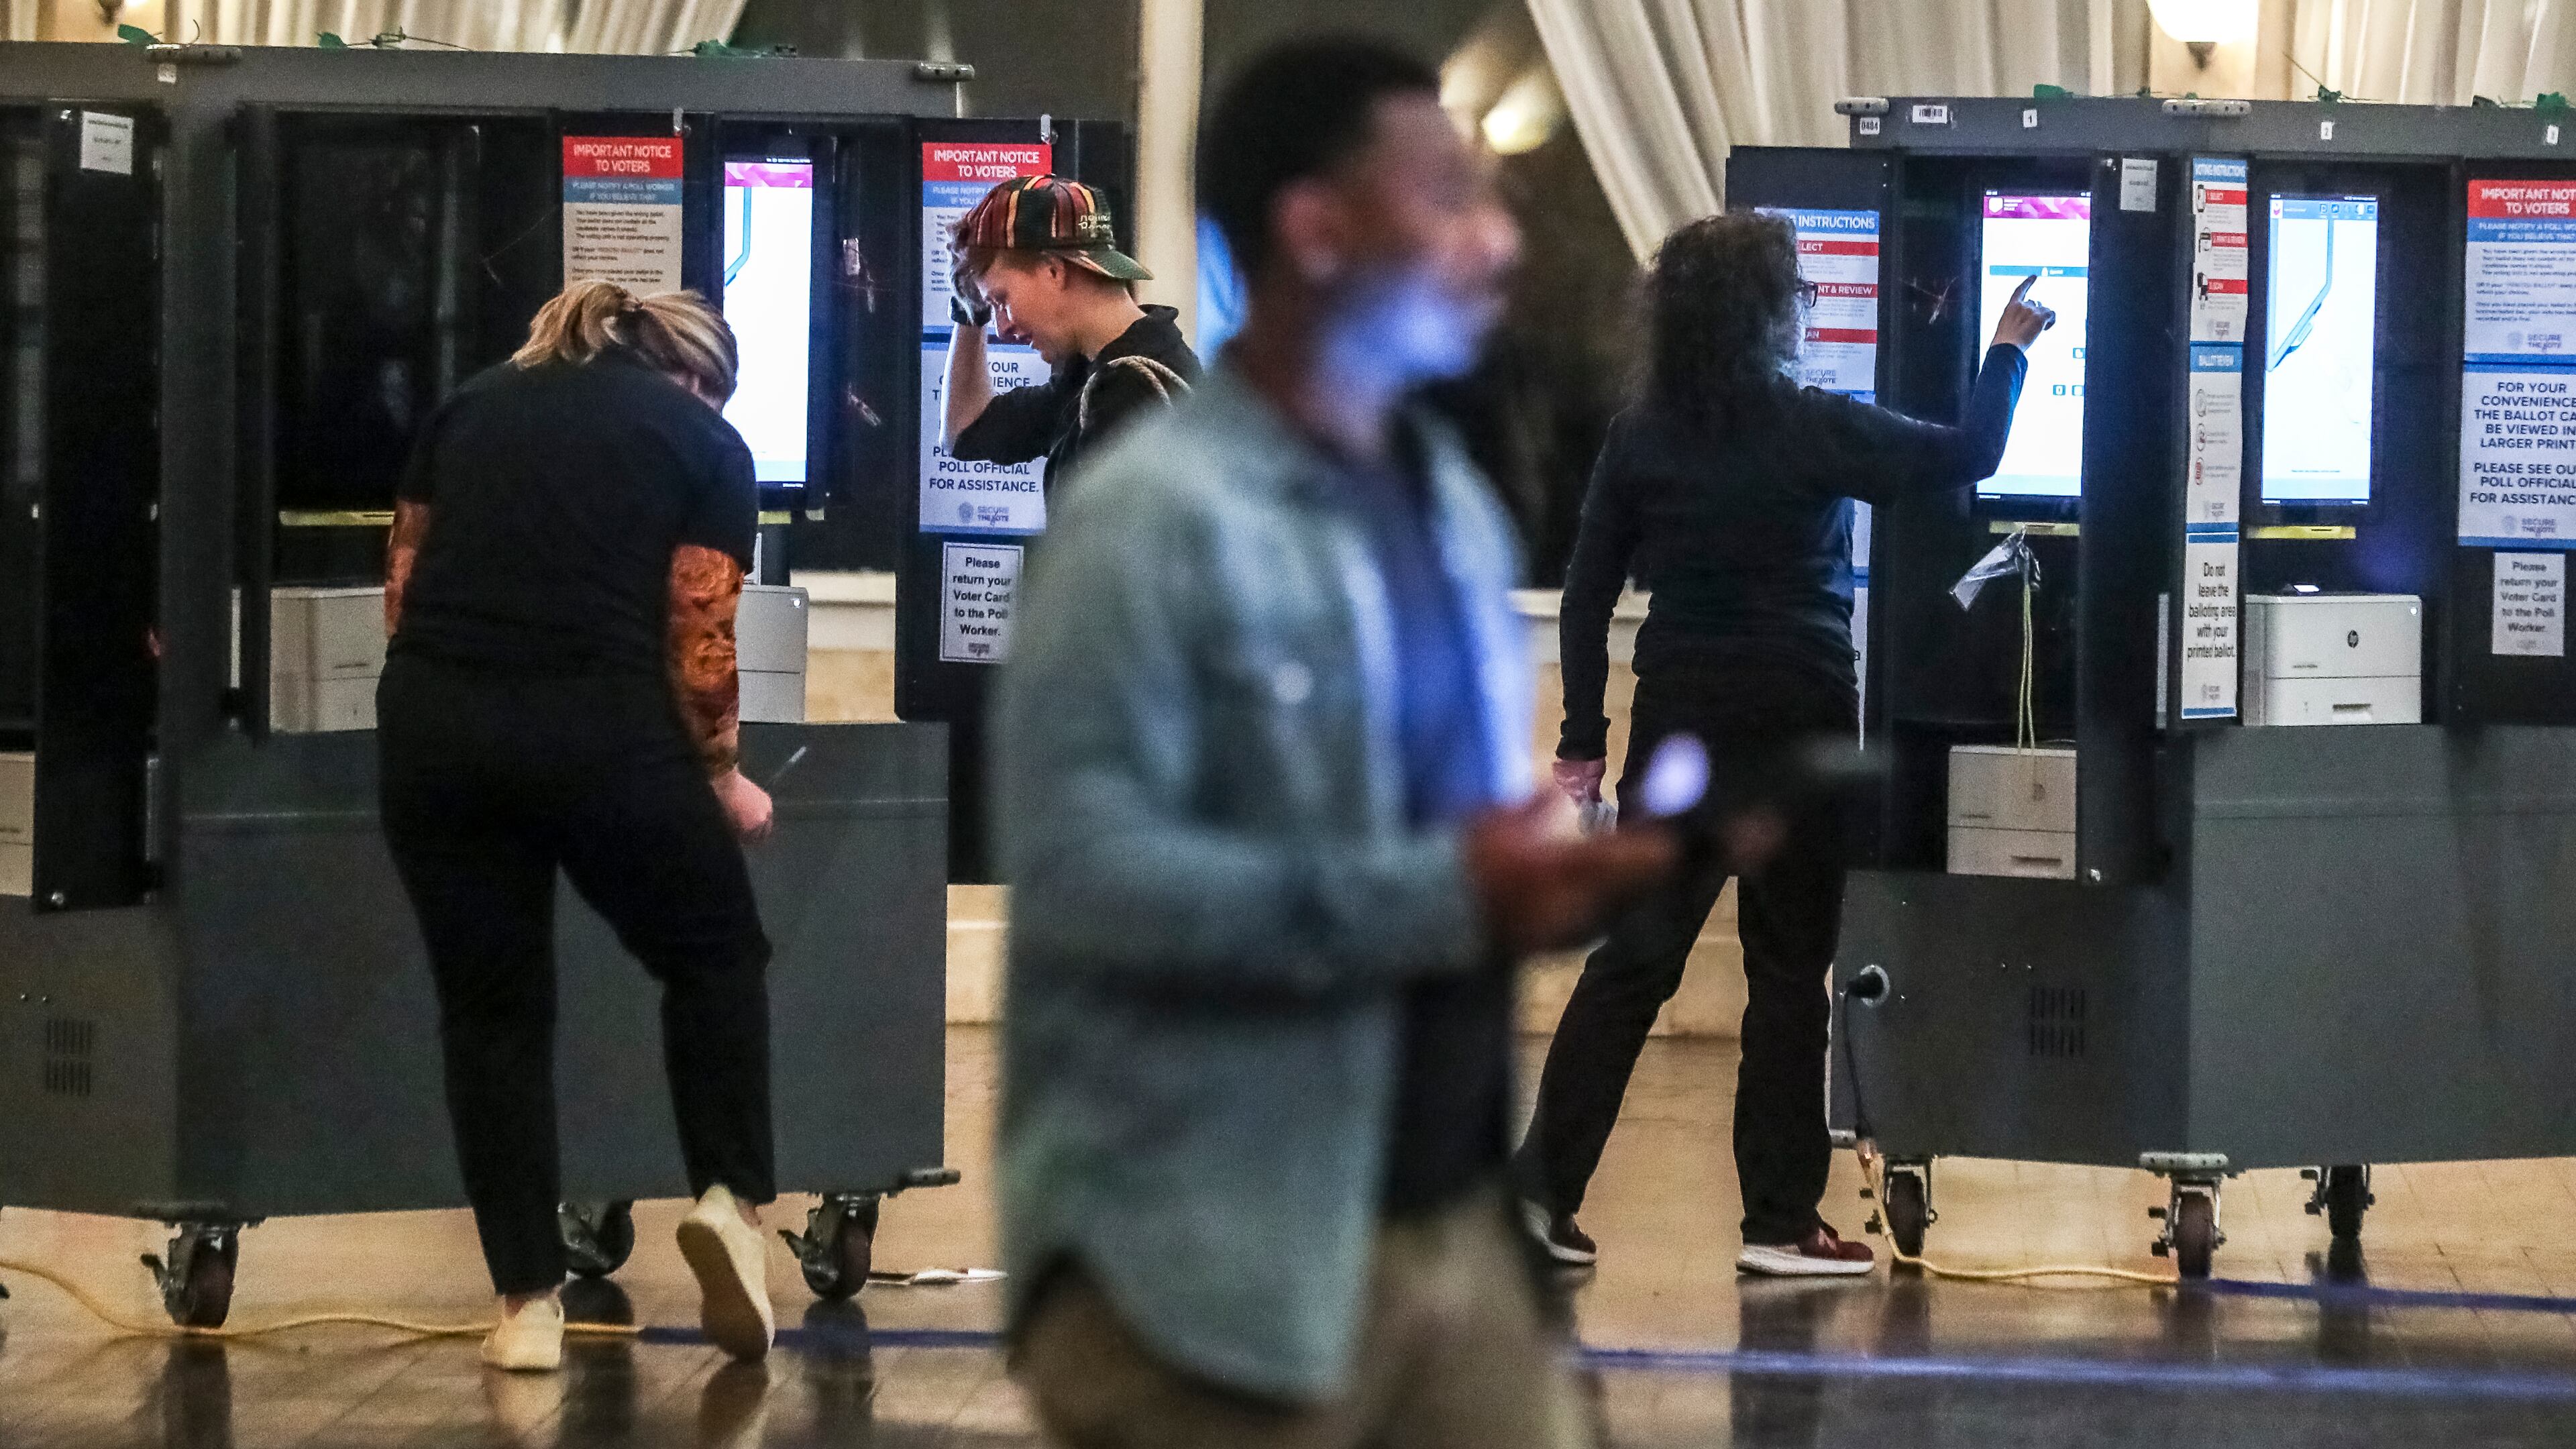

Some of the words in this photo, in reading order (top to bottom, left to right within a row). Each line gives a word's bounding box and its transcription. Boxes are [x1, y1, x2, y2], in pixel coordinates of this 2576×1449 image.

[574, 144, 633, 157] IMPORTANT
[635, 146, 672, 158] NOTICE
[934, 150, 997, 162] IMPORTANT
[1000, 151, 1039, 164] NOTICE
[596, 160, 609, 172] TO
[612, 160, 650, 173] VOTERS
[958, 165, 972, 177] TO
[975, 166, 1017, 178] VOTERS
[2481, 188, 2549, 200] IMPORTANT
[2551, 189, 2576, 201] NOT
[2506, 203, 2522, 214] TO
[2524, 203, 2570, 215] VOTERS
[1799, 215, 1875, 229] INSTRUCTIONS
[1801, 244, 1823, 252] LECT
[1838, 286, 1872, 294] REVIEW
[2498, 382, 2524, 393] FOR
[2529, 382, 2567, 394] YOUR
[2481, 396, 2576, 408] CONVENIENCE
[2474, 409, 2500, 420] THE
[2504, 410, 2555, 421] BALLOT
[2560, 411, 2576, 423] CA
[2486, 424, 2502, 434] BE
[2506, 425, 2558, 435] VIEWED
[2480, 438, 2532, 449] LARGER
[939, 462, 971, 473] POLL
[973, 462, 1030, 475] OFFICIAL
[2474, 462, 2523, 474] PLEASE
[2528, 464, 2551, 475] SEE
[2556, 464, 2576, 476] OU
[929, 478, 955, 490] FOR
[958, 479, 1040, 492] ASSISTANCE.
[2480, 476, 2514, 488] POLL
[2518, 477, 2576, 489] OFFICIAL
[2470, 492, 2497, 504] FOR
[2502, 493, 2576, 506] ASSISTANC
[965, 557, 1000, 569] Please
[2204, 562, 2214, 577] Do
[2215, 563, 2225, 577] not
[2512, 561, 2547, 572] Please
[953, 574, 985, 586] return
[987, 576, 1012, 588] your
[2500, 578, 2532, 587] return
[2534, 578, 2558, 589] your
[954, 590, 981, 602] Voter
[2198, 583, 2216, 597] leave
[2218, 584, 2229, 597] the
[2500, 592, 2529, 602] Voter
[2532, 593, 2557, 603] Card
[955, 608, 965, 618] to
[968, 608, 985, 619] the
[2189, 604, 2219, 621] balloting
[2220, 606, 2236, 617] area
[2502, 608, 2512, 617] to
[2516, 608, 2532, 617] the
[2534, 607, 2555, 618] Poll
[960, 624, 1001, 636] Worker.
[2197, 624, 2212, 637] with
[2213, 626, 2229, 640] your
[2188, 644, 2213, 662] printed
